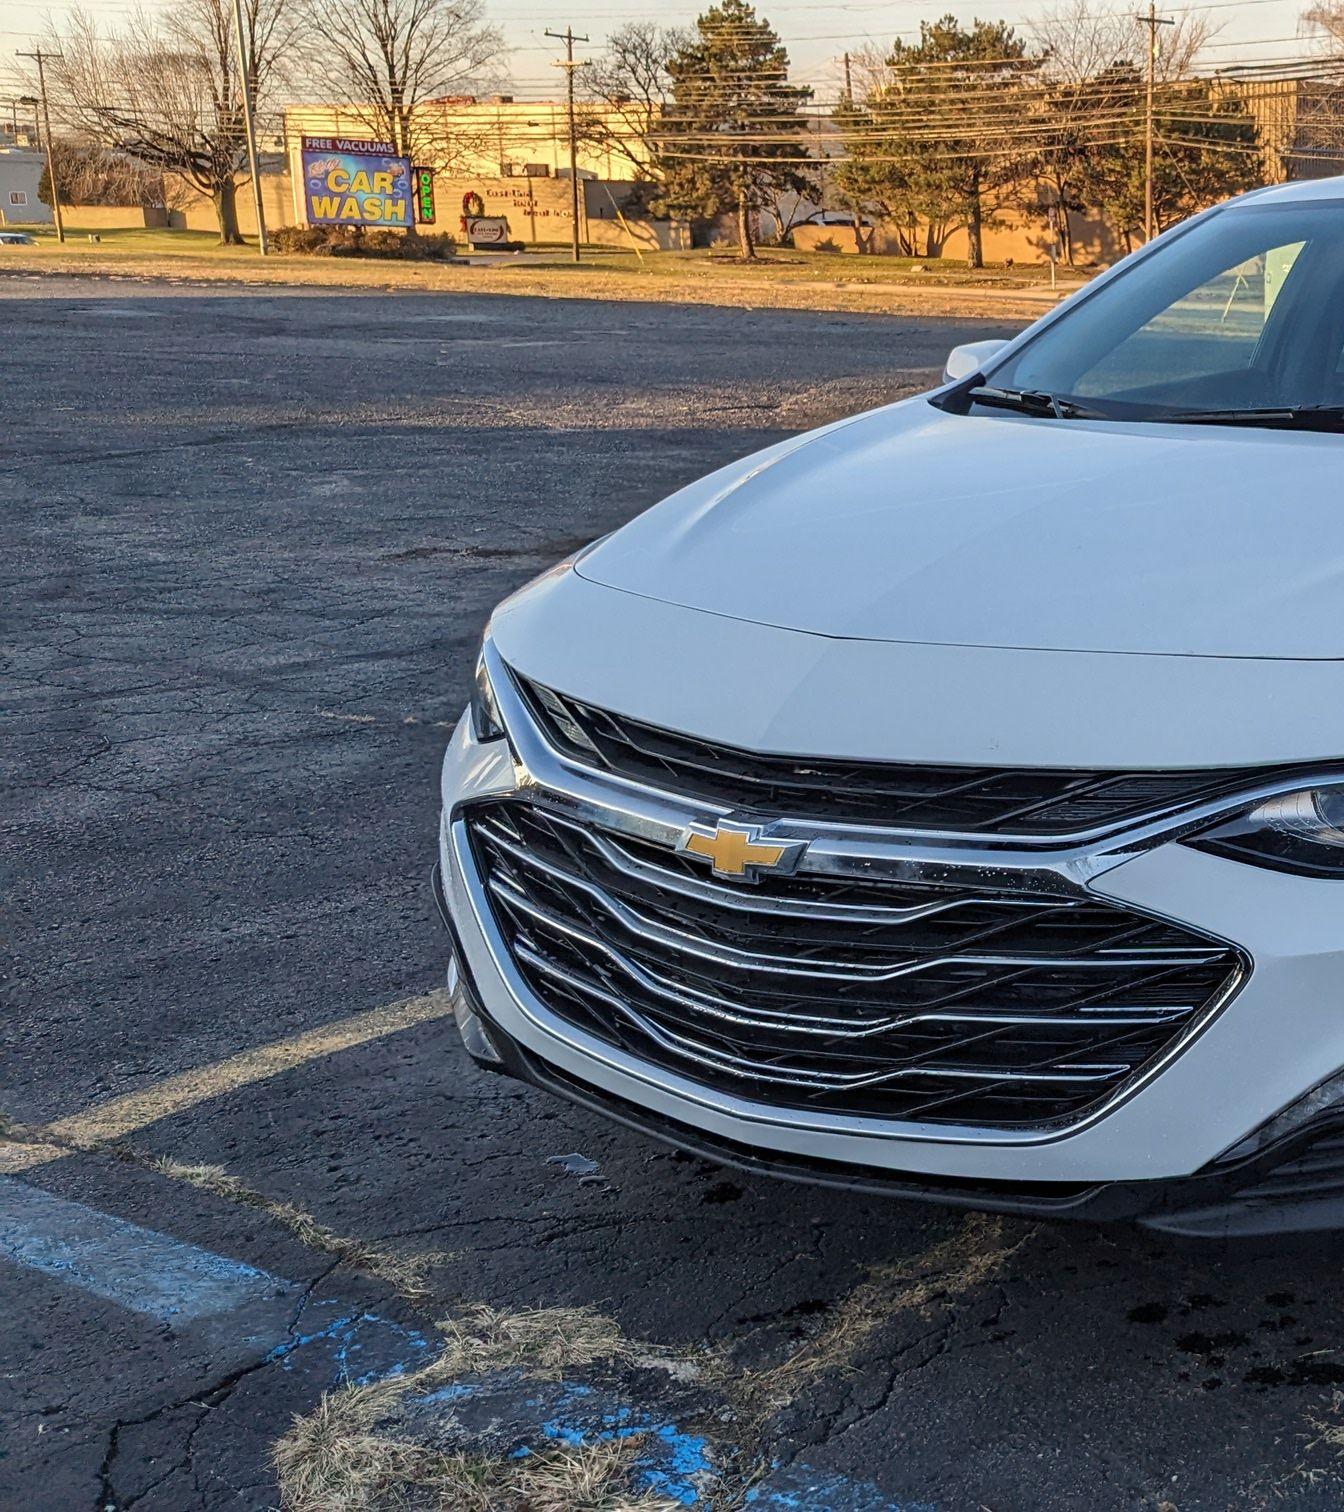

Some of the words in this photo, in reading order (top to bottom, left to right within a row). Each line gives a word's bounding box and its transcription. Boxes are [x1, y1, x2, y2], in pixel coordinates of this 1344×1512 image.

[305, 138, 333, 149] FREE
[336, 140, 394, 153] VACUUMS
[327, 169, 394, 195] CAR
[311, 196, 406, 221] WASH
[421, 173, 433, 219] OPEN
